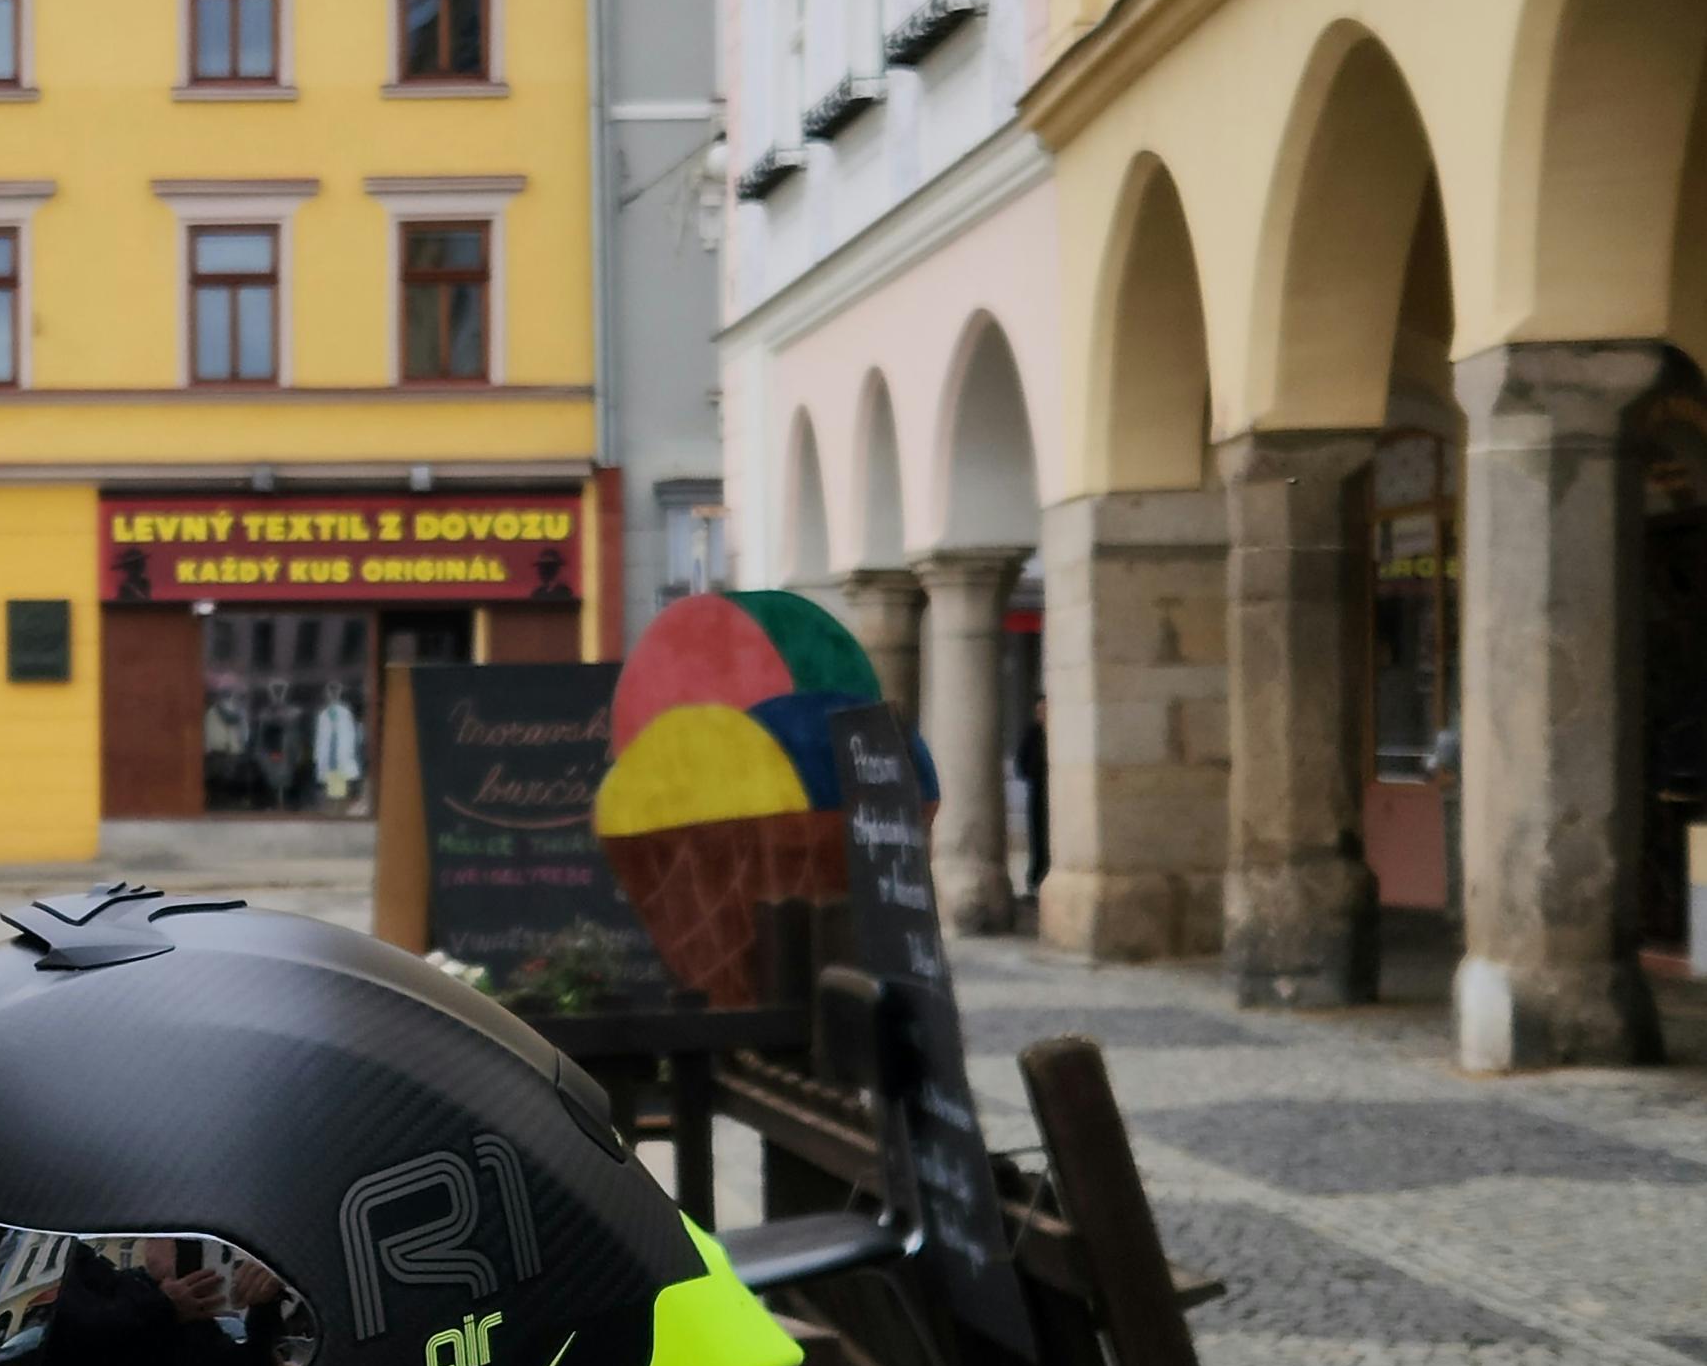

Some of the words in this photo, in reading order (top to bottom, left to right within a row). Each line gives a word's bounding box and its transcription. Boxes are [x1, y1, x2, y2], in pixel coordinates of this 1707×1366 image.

[113, 510, 233, 543] LEVNÝ
[242, 514, 370, 542] TEXTIL
[378, 514, 403, 541] Z
[415, 512, 570, 541] DOVOZU
[176, 555, 282, 584] KAŽDÝ
[289, 558, 351, 584] KUS
[361, 555, 506, 583] ORIGINÁL
[339, 1134, 542, 1341] R1
